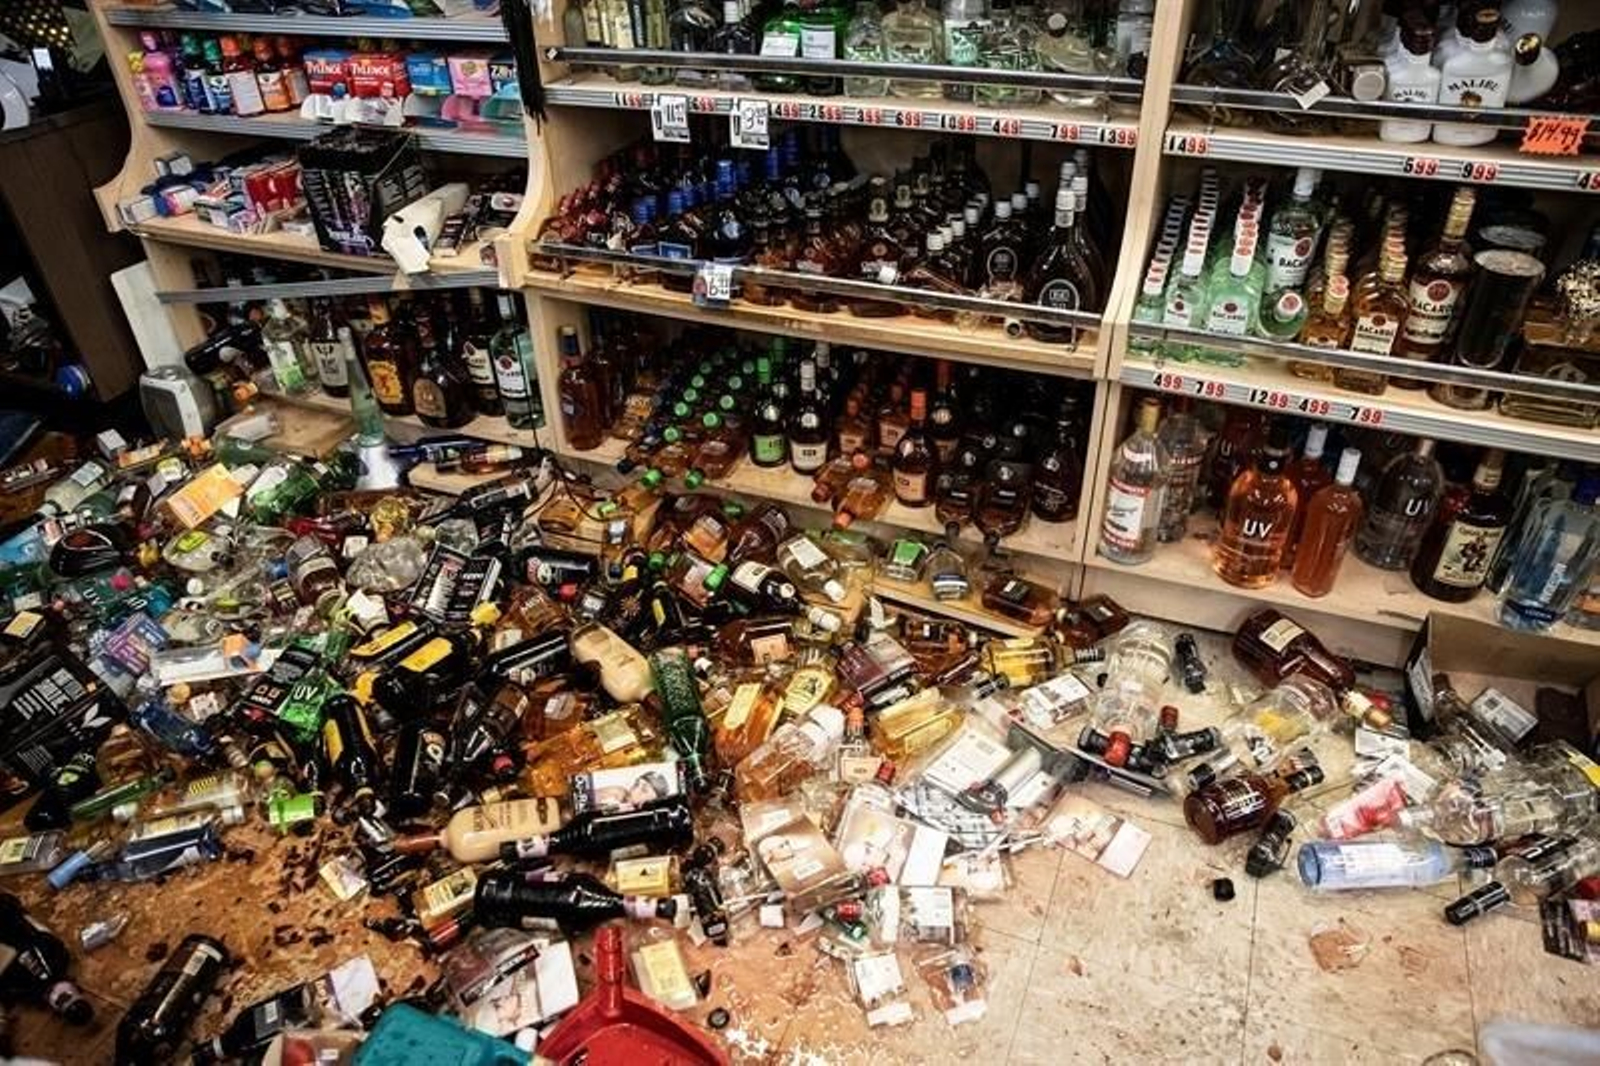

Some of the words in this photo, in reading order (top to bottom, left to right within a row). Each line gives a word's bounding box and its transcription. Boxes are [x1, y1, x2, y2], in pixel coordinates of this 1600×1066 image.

[1153, 374, 1183, 390] 499
[1250, 389, 1289, 408] 1299
[1299, 398, 1330, 415] 499
[1351, 406, 1383, 424] 799
[1243, 518, 1272, 538] UV
[293, 685, 318, 700] UV
